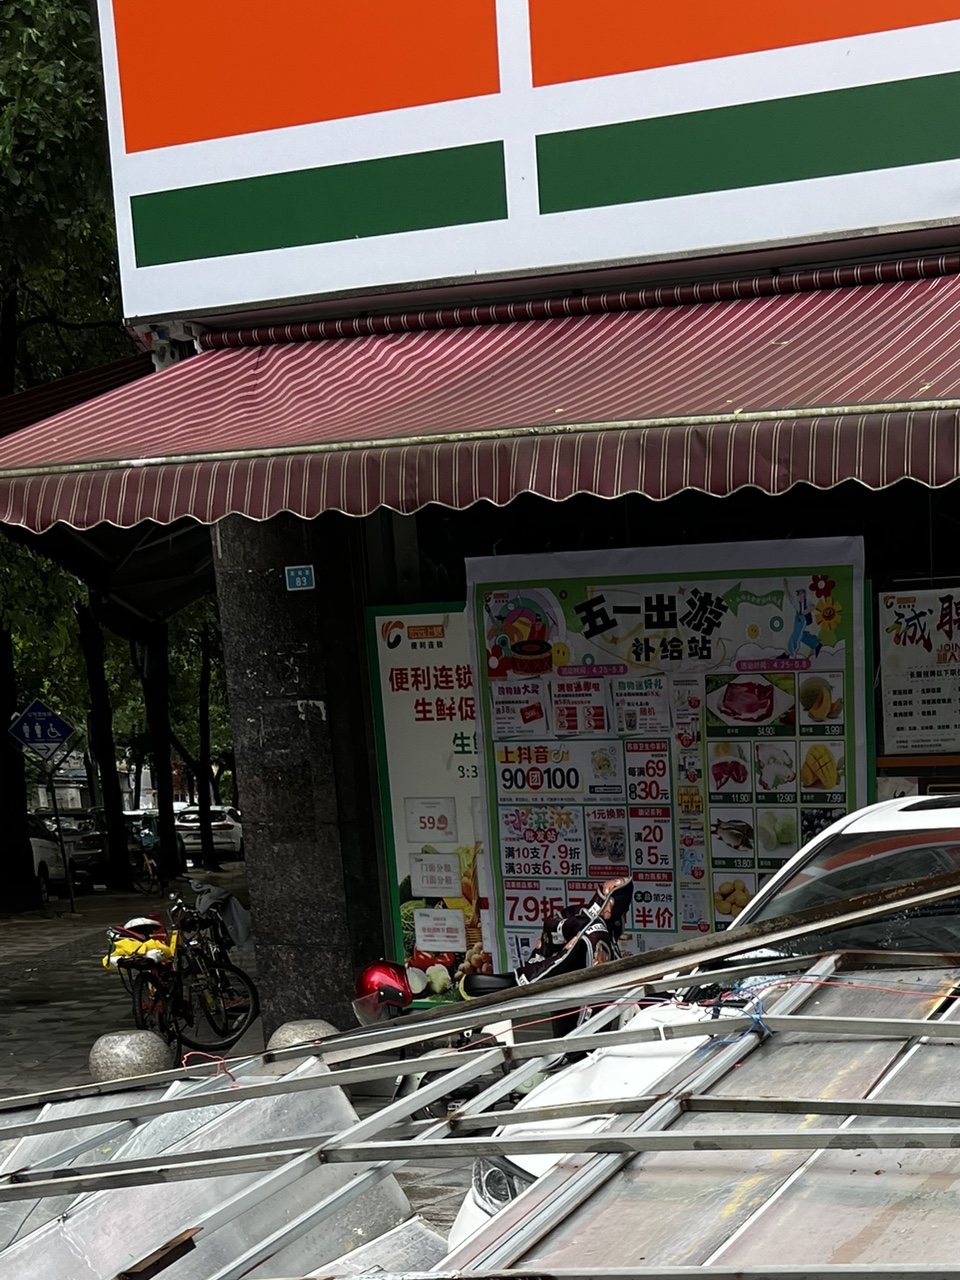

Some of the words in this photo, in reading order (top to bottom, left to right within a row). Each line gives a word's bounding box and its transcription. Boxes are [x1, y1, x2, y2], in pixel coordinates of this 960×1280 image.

[573, 588, 729, 639] 五一出游
[632, 636, 712, 661] 补给站
[389, 664, 474, 692] 便利连锁
[452, 731, 478, 755] 生
[500, 745, 549, 764] 上抖音
[635, 906, 674, 929] 半价
